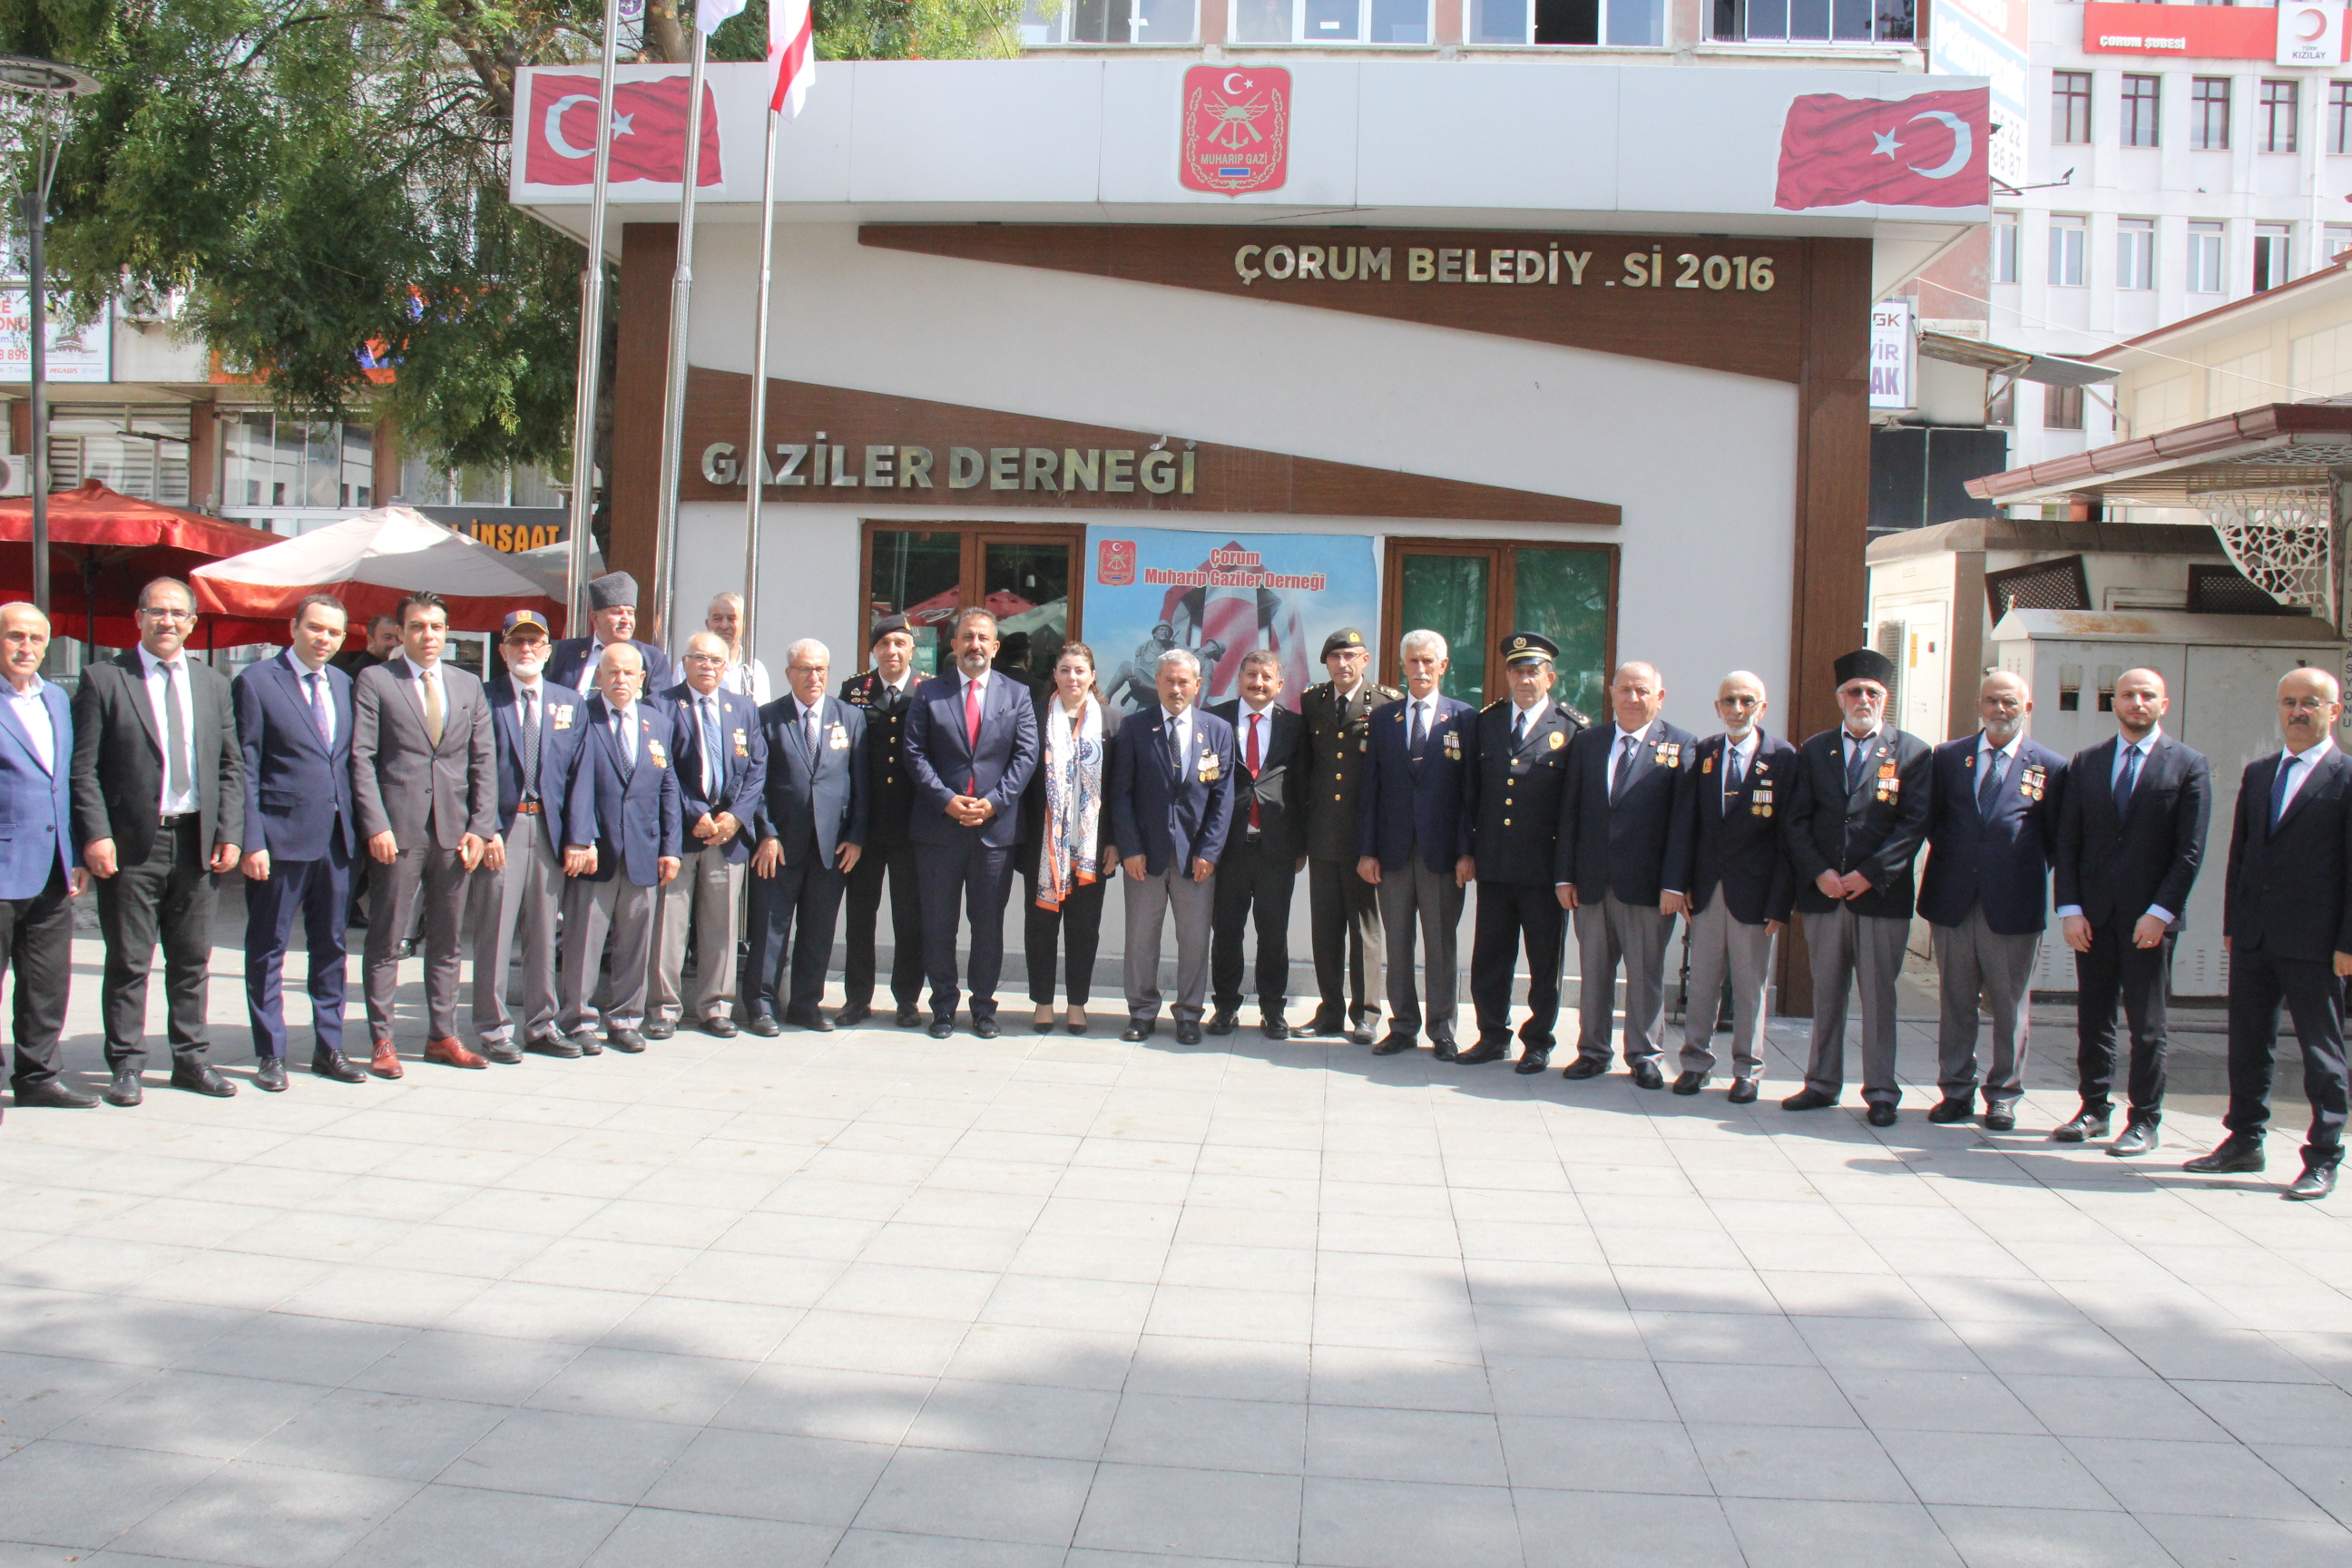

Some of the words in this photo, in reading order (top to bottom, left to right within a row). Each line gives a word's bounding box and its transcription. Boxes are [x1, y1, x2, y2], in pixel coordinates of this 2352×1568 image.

[2099, 35, 2141, 47] ÇORUM
[2144, 36, 2185, 50] ŞUBESİ
[2292, 51, 2327, 59] KIZILAY
[1246, 152, 1268, 164] GAZİ
[1234, 244, 1391, 286] ÇORUM
[1675, 253, 1774, 291] 2016
[7, 349, 28, 360] 896
[701, 431, 934, 489] GAZİLER
[949, 434, 1195, 495] DERNEĞİ
[1210, 548, 1260, 568] Çorum
[1144, 568, 1208, 587] Muharip
[1210, 569, 1262, 588] Gaziler
[1265, 572, 1326, 592] Derneği
